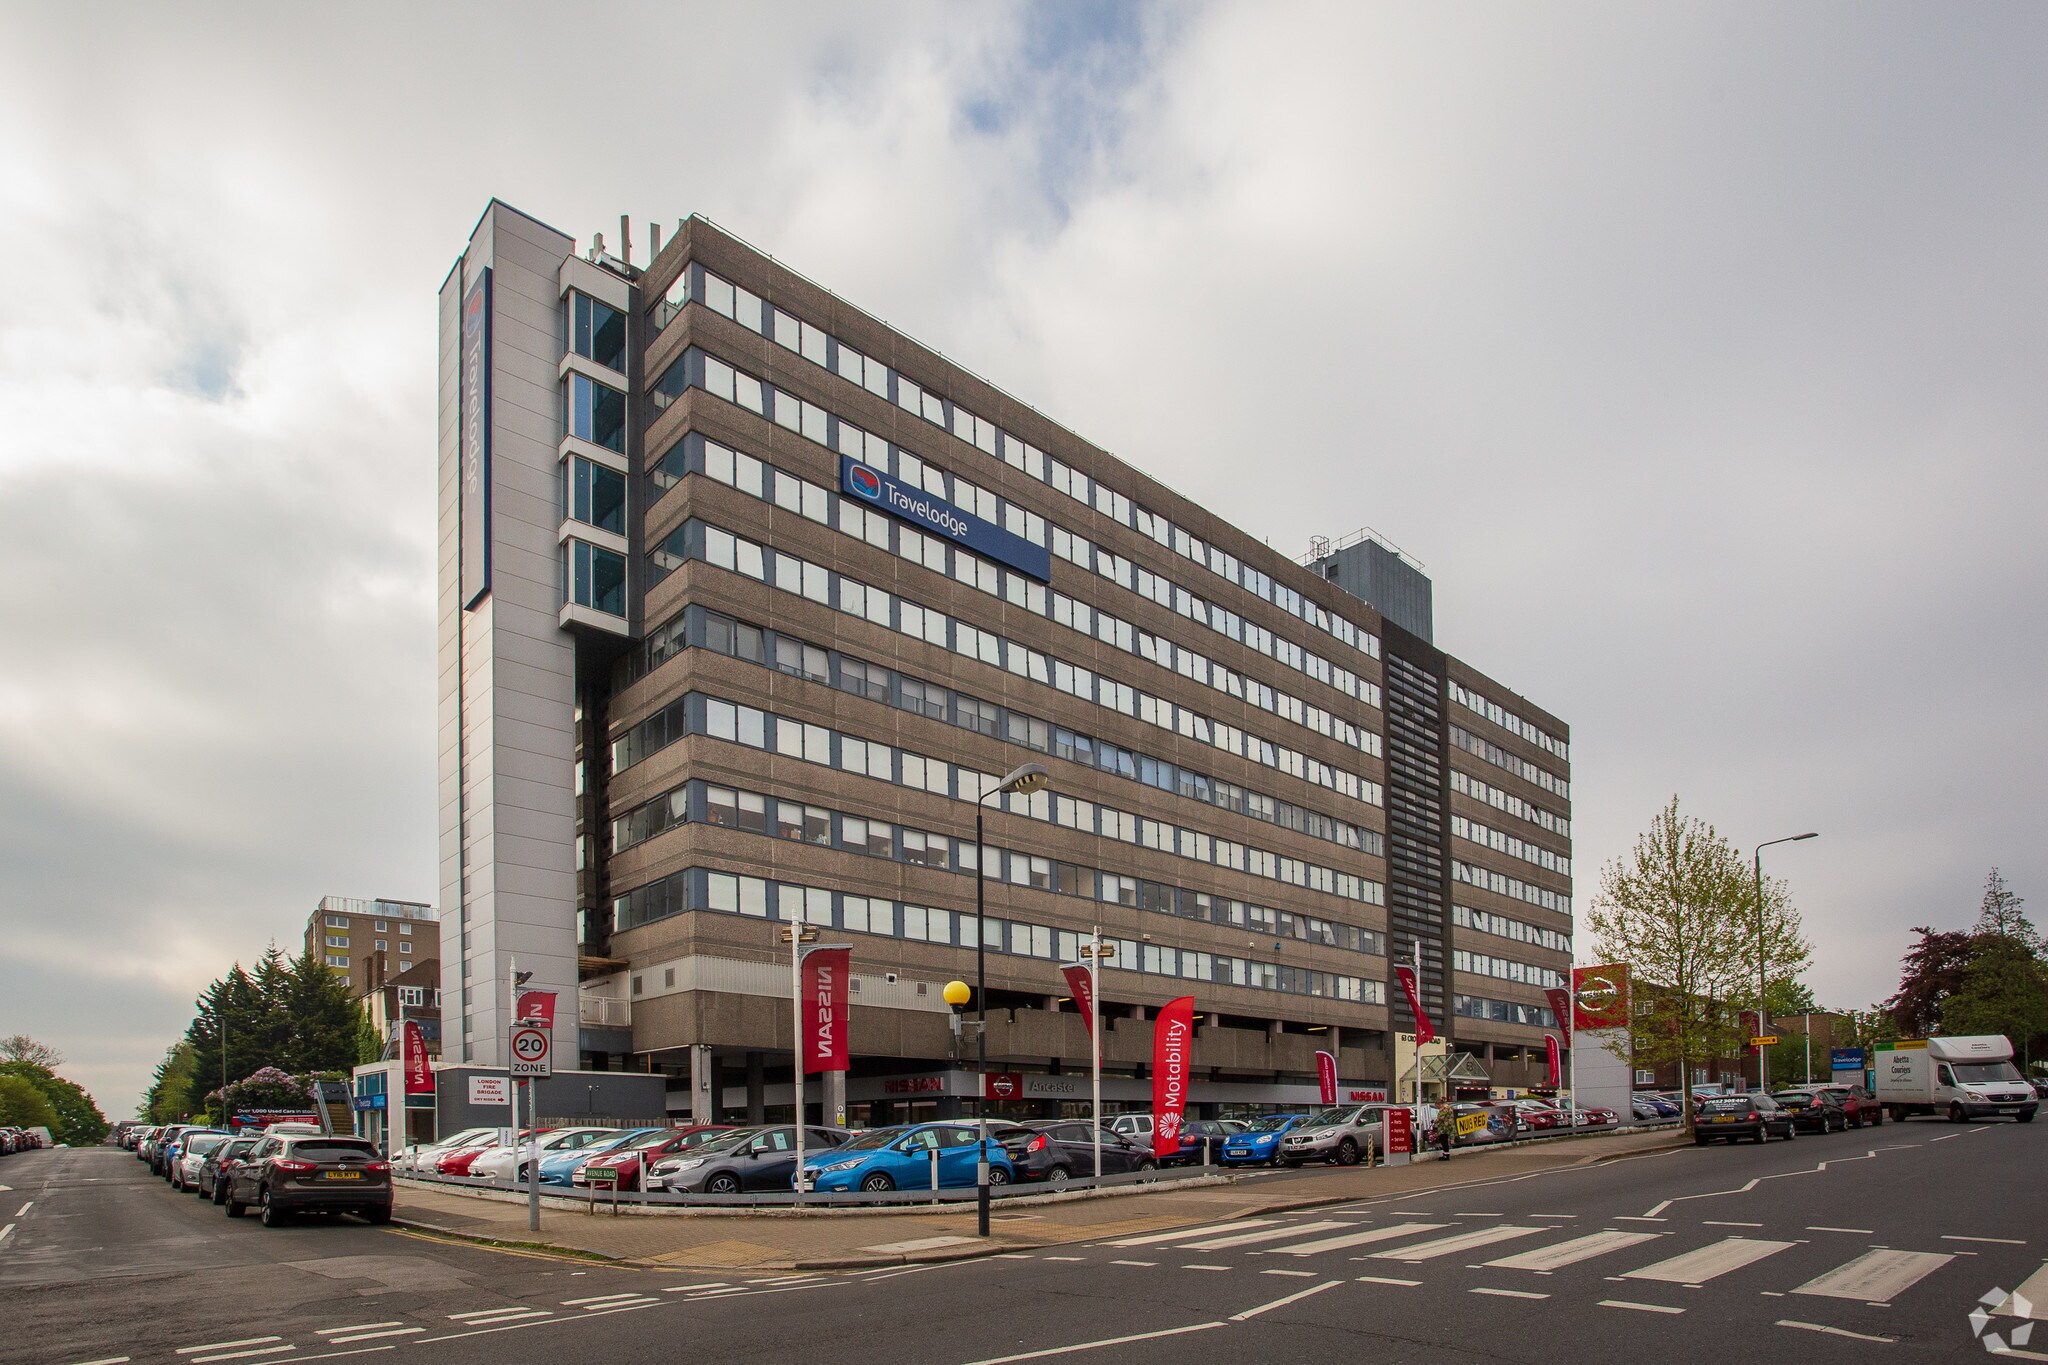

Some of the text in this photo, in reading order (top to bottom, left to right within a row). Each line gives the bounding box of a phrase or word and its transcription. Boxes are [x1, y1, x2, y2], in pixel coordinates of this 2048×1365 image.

[467, 331, 481, 495] Travelodge
[885, 481, 968, 537] Travelodge
[518, 1038, 543, 1052] 20
[514, 1063, 546, 1073] ZONE
[1165, 1019, 1187, 1107] Motability
[885, 1077, 944, 1093] NISSAN
[1350, 1091, 1385, 1101] NISSAN
[1474, 1114, 1486, 1127] REG
[603, 1170, 616, 1178] ROAD
